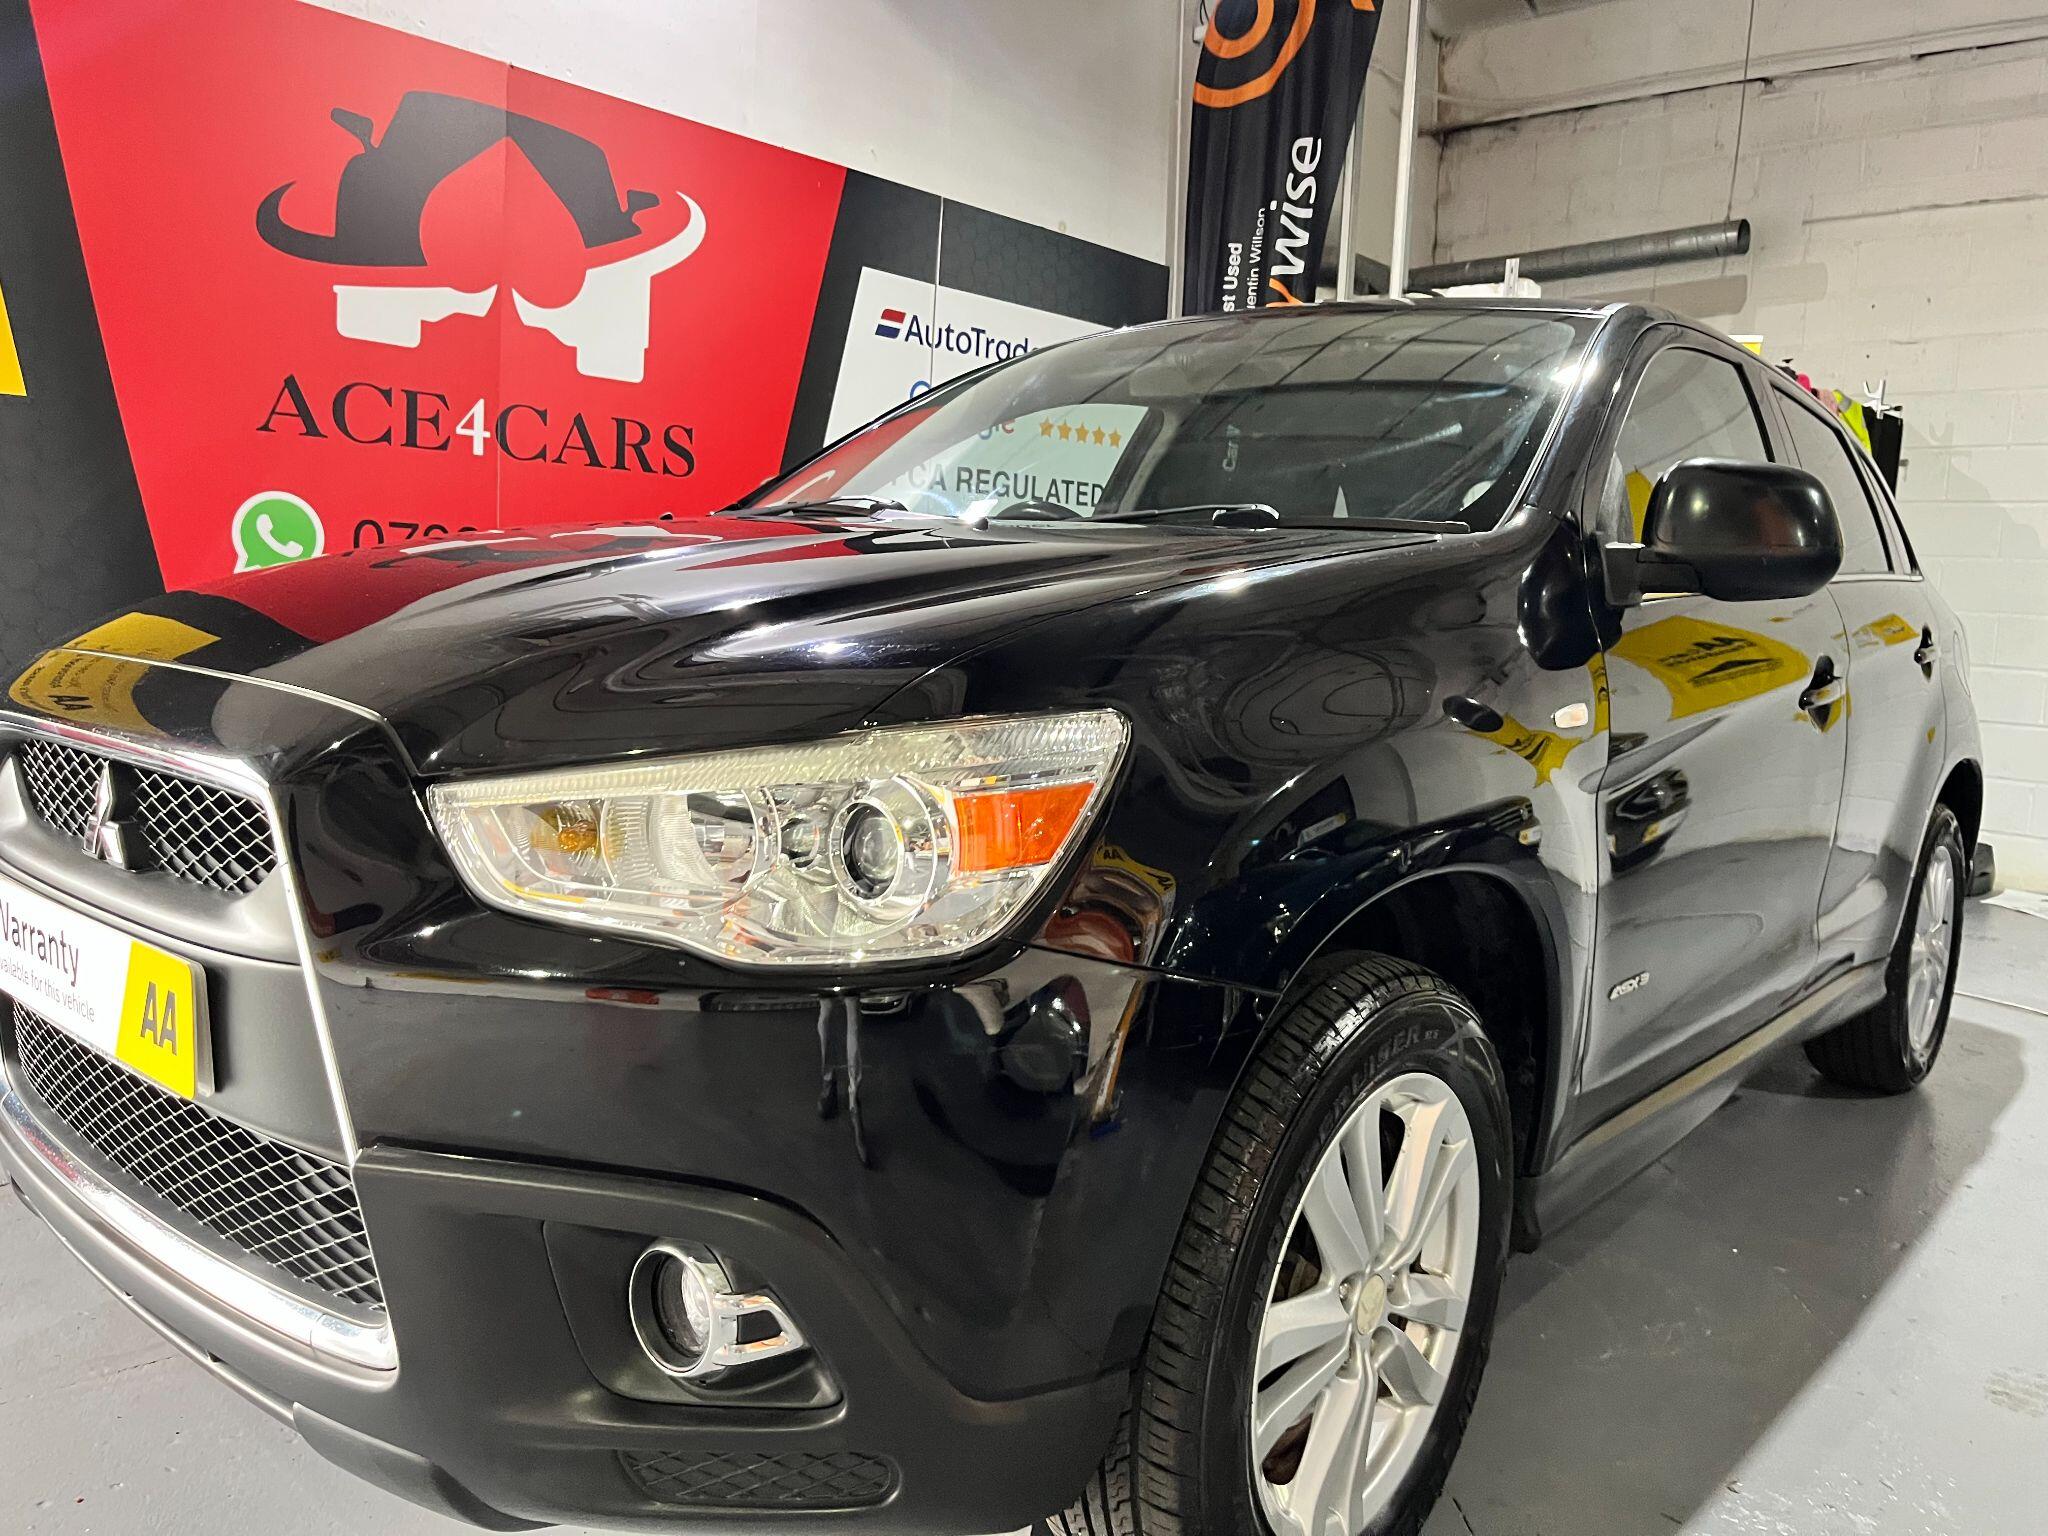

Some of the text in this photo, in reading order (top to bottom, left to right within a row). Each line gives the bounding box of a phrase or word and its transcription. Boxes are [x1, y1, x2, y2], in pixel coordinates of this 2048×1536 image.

[1249, 207, 1266, 263] Willson
[1222, 242, 1243, 289] Used
[904, 314, 1039, 361] AutoTrad
[256, 373, 696, 478] ACE4CARS
[62, 991, 95, 1022] vehicle
[140, 981, 178, 1056] AA
